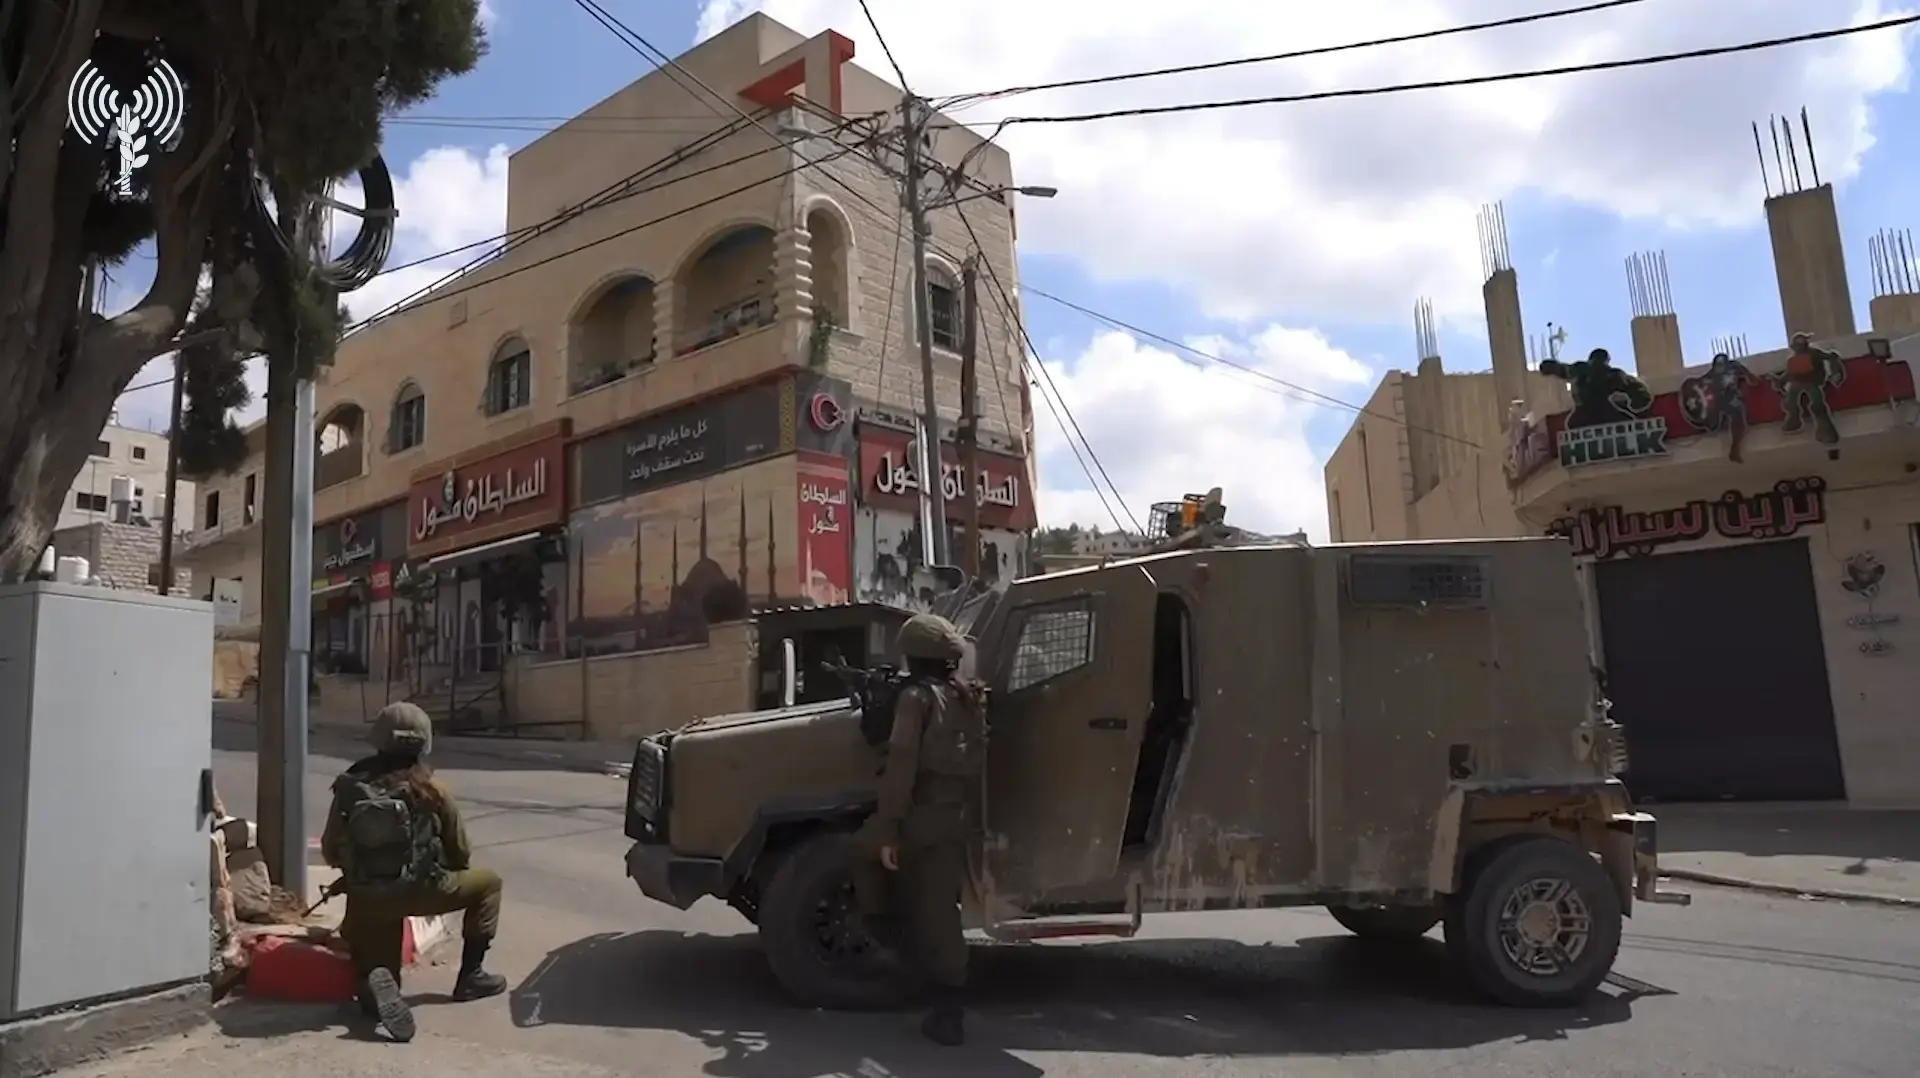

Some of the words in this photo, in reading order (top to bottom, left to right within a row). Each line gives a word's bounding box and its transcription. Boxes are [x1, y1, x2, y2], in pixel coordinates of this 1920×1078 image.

[680, 424, 692, 439] ما
[692, 418, 709, 440] كل
[682, 446, 705, 465] تحت
[1561, 430, 1668, 467] HULK
[628, 462, 651, 481] واحد
[651, 454, 682, 474] سقف
[463, 456, 545, 523] السلطان
[800, 482, 847, 505] السلطان
[415, 496, 463, 541] مول
[1715, 477, 1826, 538] تزين
[808, 512, 840, 535] مول
